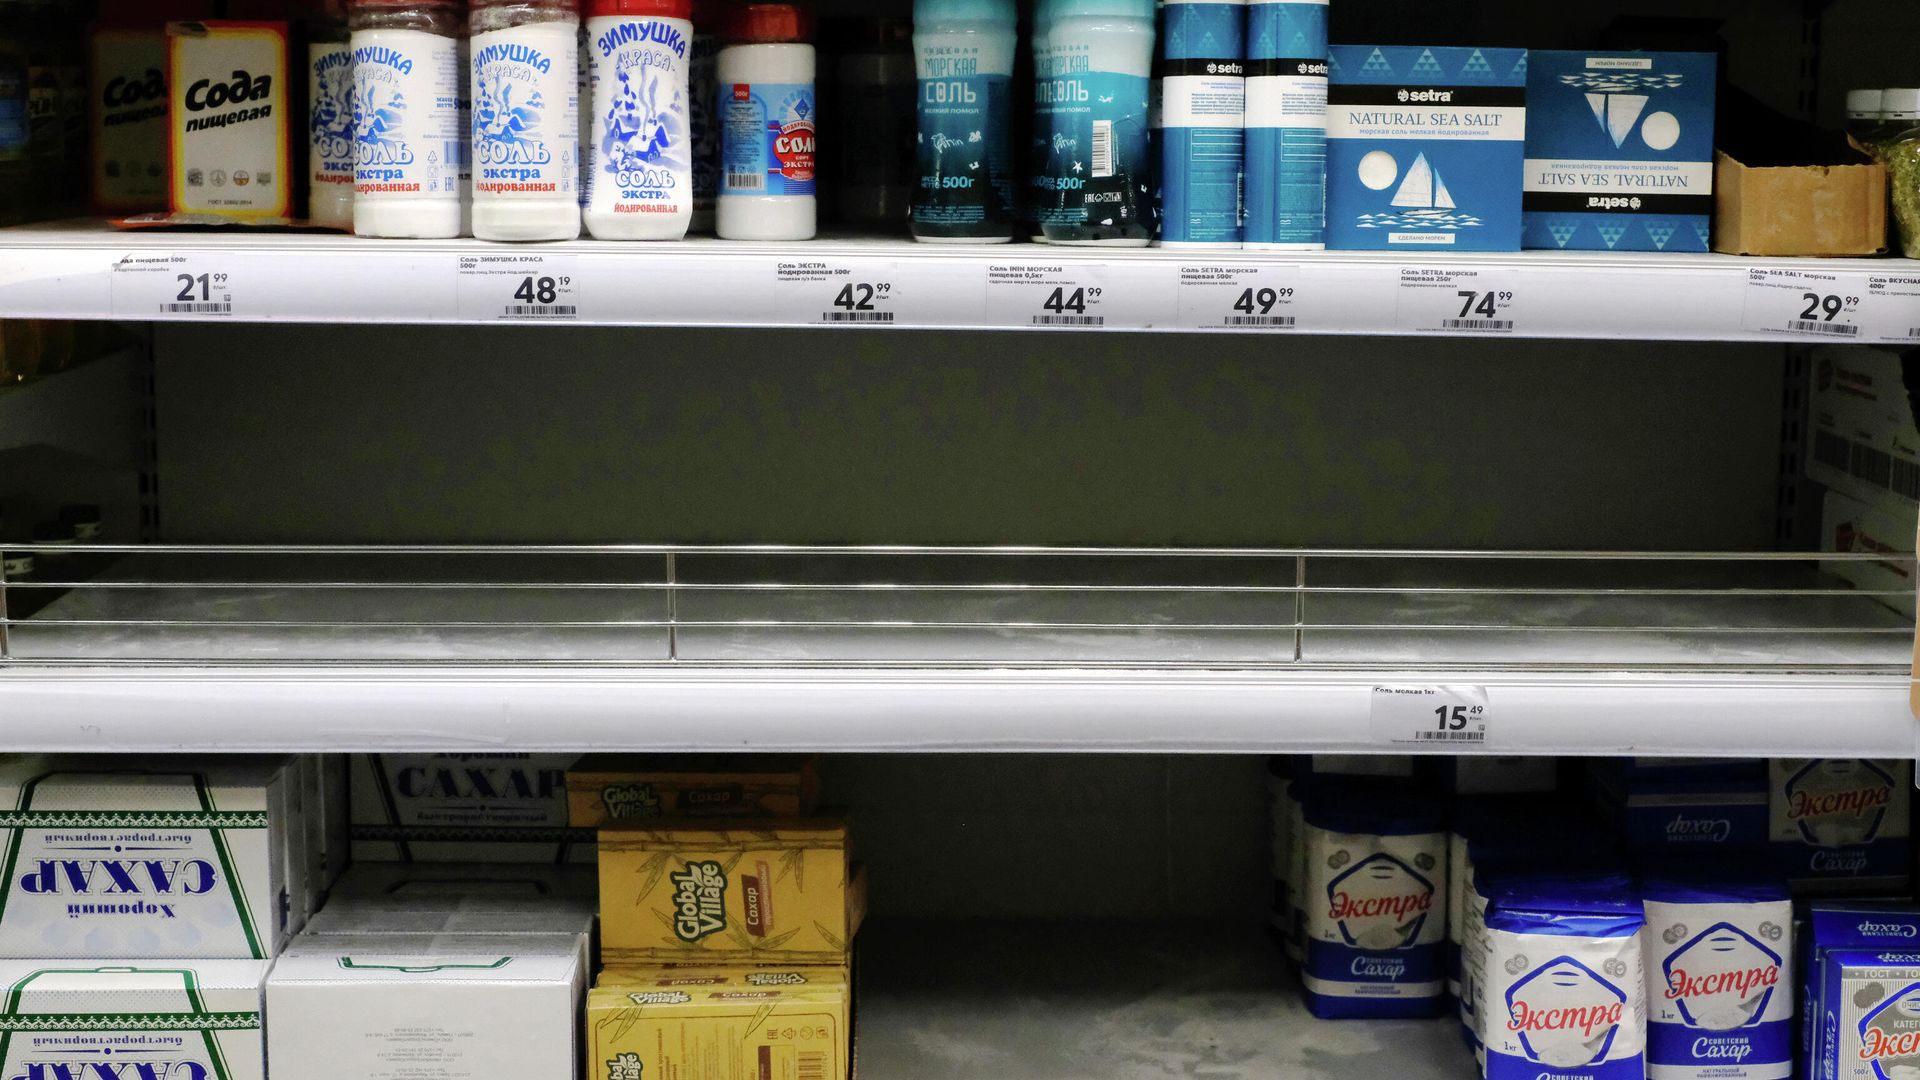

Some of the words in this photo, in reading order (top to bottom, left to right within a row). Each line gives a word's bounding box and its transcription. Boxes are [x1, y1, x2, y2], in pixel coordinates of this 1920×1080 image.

[598, 22, 686, 59] ЗИМУШКА
[313, 51, 353, 77] ЗИМУ
[473, 44, 551, 74] ЗИМУШКА
[620, 49, 671, 71] КРАСА
[925, 58, 977, 77] МОРСКАЯ
[484, 63, 532, 82] КРАСА
[104, 69, 168, 107] Сод
[185, 70, 272, 112] Сода
[926, 82, 977, 103] СОЛЬ
[1410, 90, 1452, 102] setra
[186, 105, 272, 132] пищевая
[1349, 112, 1425, 125] NATURAL
[1430, 113, 1460, 126] SEA
[1464, 114, 1502, 127] SALT
[1438, 129, 1489, 137] йодированная
[479, 140, 551, 165] СОЛЬ
[323, 161, 353, 171] экст
[483, 168, 541, 181] экстра
[476, 180, 556, 193] йодированная
[615, 170, 675, 188] СОЛЬ
[942, 177, 975, 188] 500г
[1056, 178, 1086, 189] 500г
[1538, 173, 1576, 185] SALT
[1580, 174, 1609, 185] SEA
[1613, 175, 1688, 187] NATURAL
[622, 190, 671, 200] ЭКСТРА
[1588, 197, 1629, 208] setra
[614, 203, 678, 214] ЙОДИРОВАННАЯ
[177, 273, 209, 301] 21
[214, 273, 228, 283] 99
[1804, 273, 1836, 281] морская
[514, 277, 557, 304] 48
[559, 277, 571, 285] 19
[834, 283, 874, 310] 42
[877, 283, 891, 292] 99
[1044, 287, 1086, 314] 44
[1088, 288, 1102, 296] 99
[1234, 288, 1277, 314] 49
[1280, 288, 1294, 296] 99
[1458, 291, 1496, 318] 74
[1499, 292, 1512, 300] 99
[1800, 293, 1842, 321] 29
[1846, 297, 1859, 305] 99
[1435, 705, 1467, 730] 15
[1470, 706, 1483, 714] 49
[603, 787, 656, 803] Global
[1787, 785, 1892, 818] Экстра
[45, 833, 191, 844] быстрорастворимый
[1666, 814, 1731, 842] Сахар
[1809, 850, 1869, 877] Сахар
[19, 859, 217, 894] САХАР
[67, 901, 175, 918] Хороший
[675, 866, 700, 939] Global
[699, 863, 724, 933] Village
[747, 887, 759, 926] Сахар
[1329, 892, 1433, 922] Экстра
[1857, 920, 1917, 938] Сахар
[1351, 956, 1405, 980] Сахар
[1864, 970, 1890, 978] ГОСТ
[1905, 970, 1920, 978] ГО
[1664, 965, 1779, 999] Экстра
[1507, 1001, 1623, 1037] Экстра
[33, 1035, 182, 1046] быстрорастворимый
[1692, 1037, 1752, 1063] Сахар
